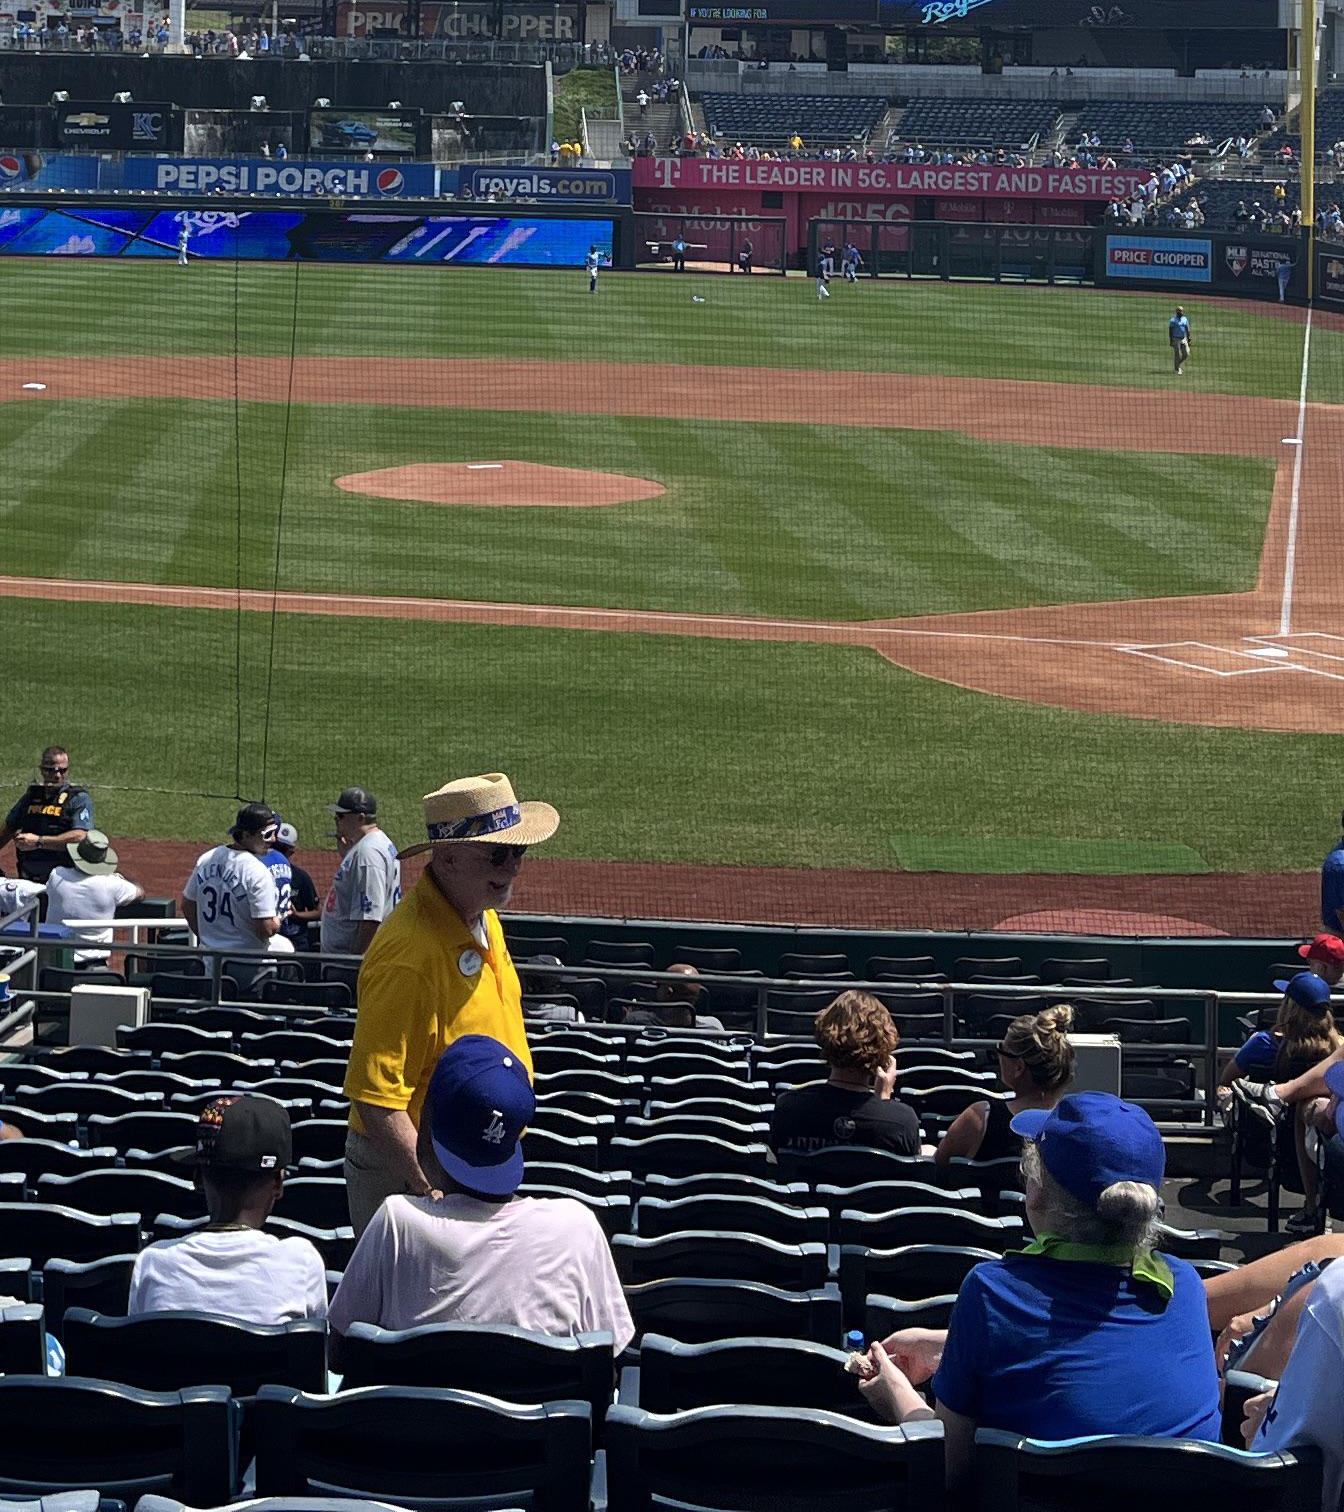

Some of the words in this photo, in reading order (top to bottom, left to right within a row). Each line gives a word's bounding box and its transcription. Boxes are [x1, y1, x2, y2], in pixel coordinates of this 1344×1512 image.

[156, 165, 249, 191] PEPSI
[256, 166, 369, 194] PORCH
[478, 172, 608, 198] royals.com
[699, 164, 739, 184] THE
[745, 166, 826, 186] LEADER
[831, 168, 853, 187] IN
[858, 168, 891, 188] 5G.
[897, 170, 992, 191] LARGEST
[995, 173, 1043, 193] AND
[1048, 175, 1142, 196] FASTEST
[1114, 250, 1147, 263] PRICE
[1154, 252, 1205, 266] CHOPPER
[196, 862, 248, 902] ALENUELA
[202, 886, 235, 927] 34
[481, 1109, 506, 1144] LA
